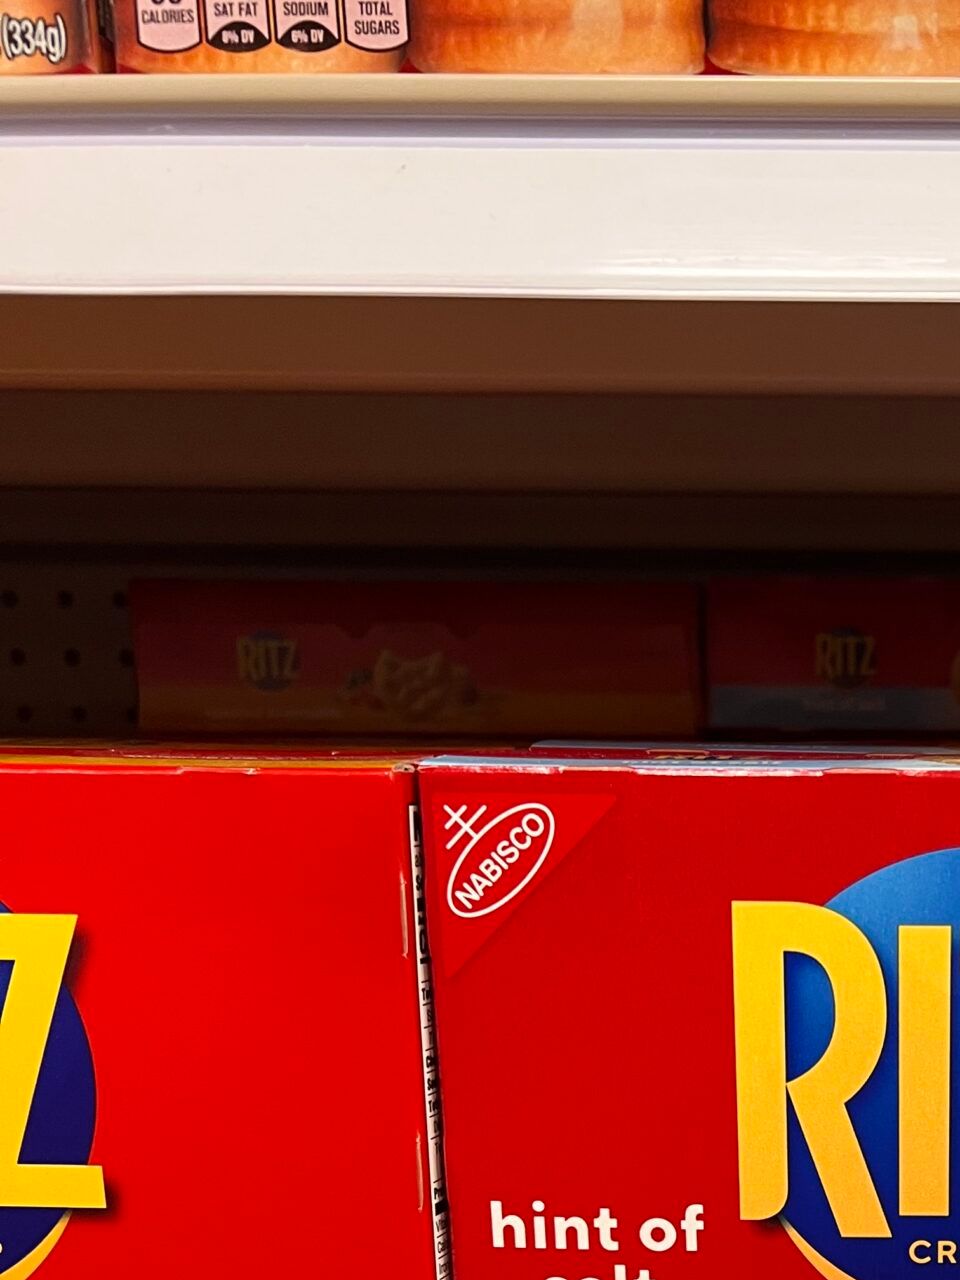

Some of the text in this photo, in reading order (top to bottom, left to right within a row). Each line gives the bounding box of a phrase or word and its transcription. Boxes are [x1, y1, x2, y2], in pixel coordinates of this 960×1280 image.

[2, 13, 66, 64] (334g)
[141, 10, 195, 24] CALORIES
[236, 638, 298, 681] RITZ
[814, 633, 878, 681] RITZ
[455, 813, 546, 909] NABISCO
[490, 1200, 705, 1252] hint of
